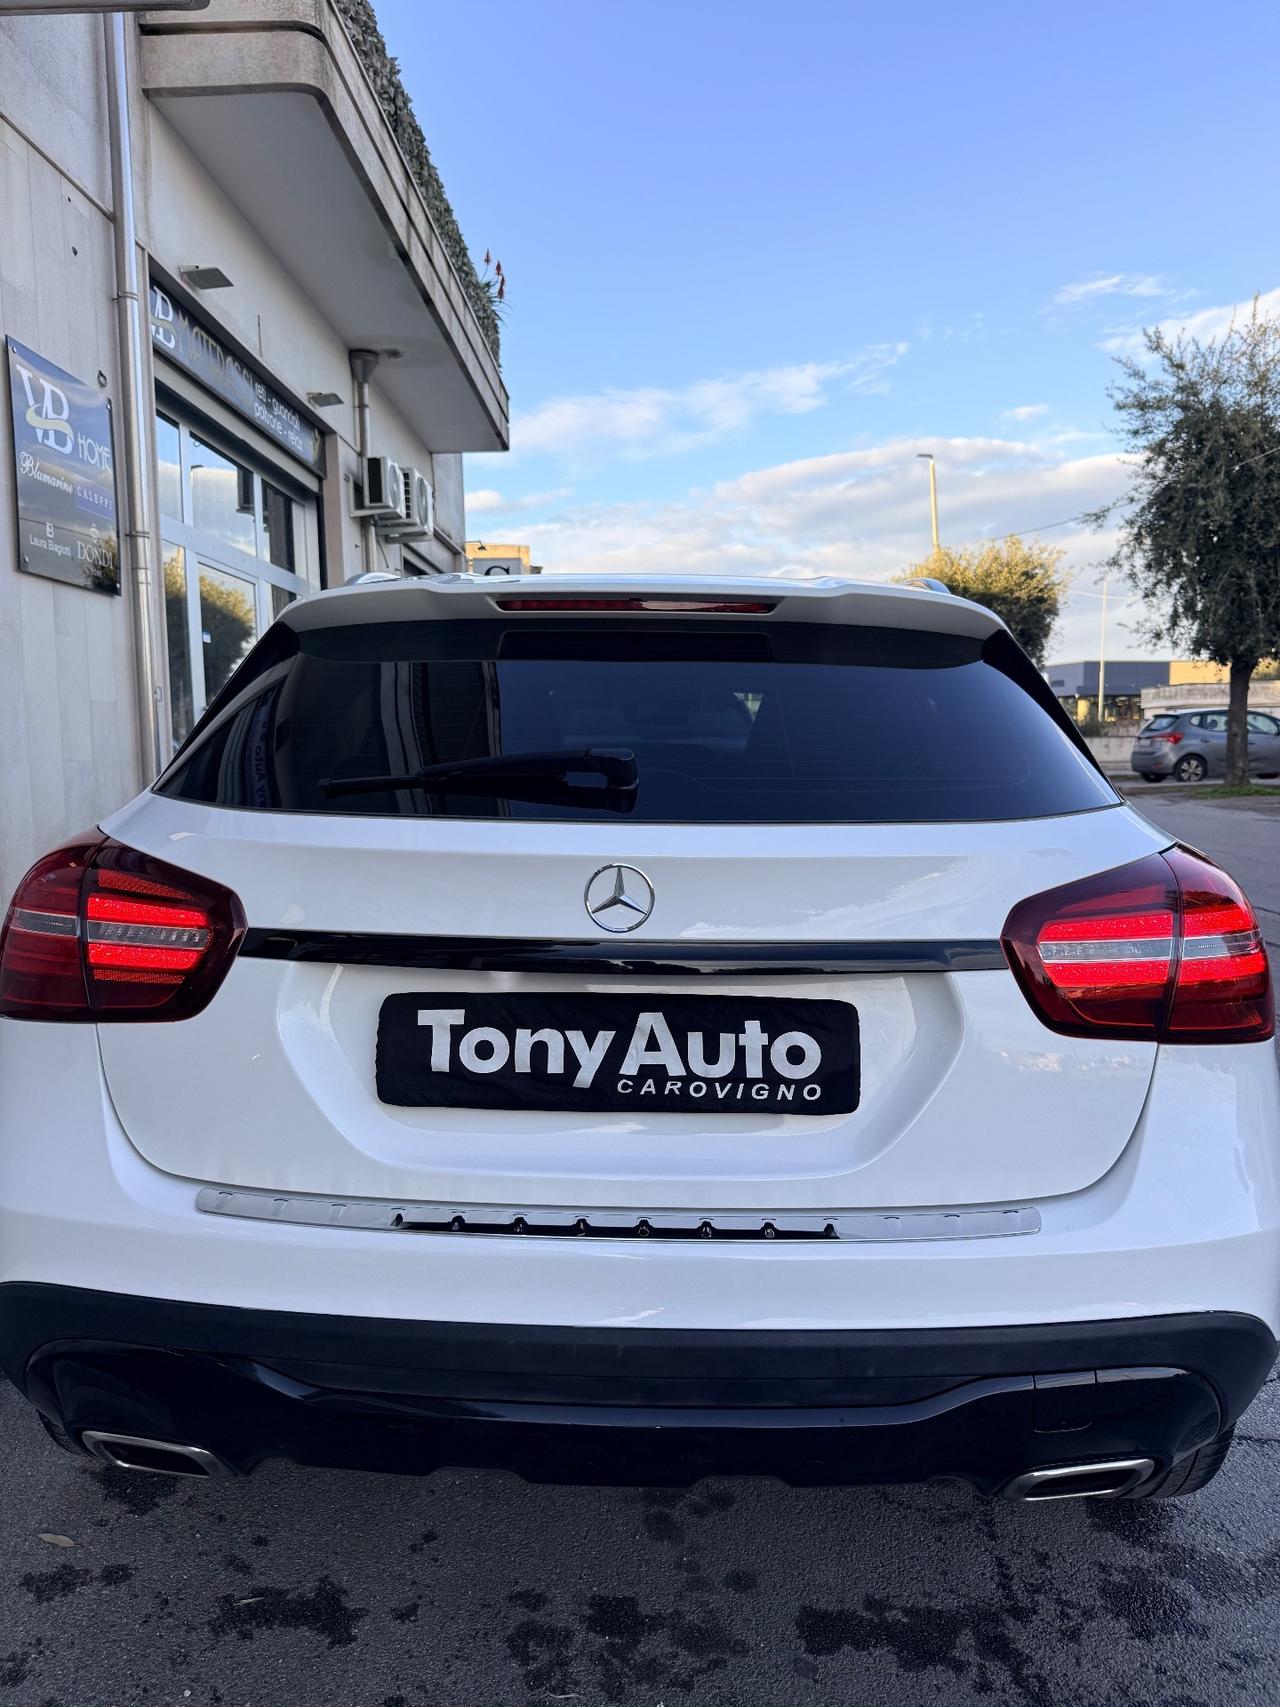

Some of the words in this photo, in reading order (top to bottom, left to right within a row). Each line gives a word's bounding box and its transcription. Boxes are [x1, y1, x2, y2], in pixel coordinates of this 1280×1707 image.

[77, 431, 112, 475] HOME
[20, 451, 74, 494] Blumarine
[77, 486, 113, 510] CALEFFI
[77, 540, 113, 569] DONDI
[418, 1008, 617, 1089] Tony
[619, 1012, 822, 1080] Auto
[616, 1078, 822, 1101] CAROVIGNO
